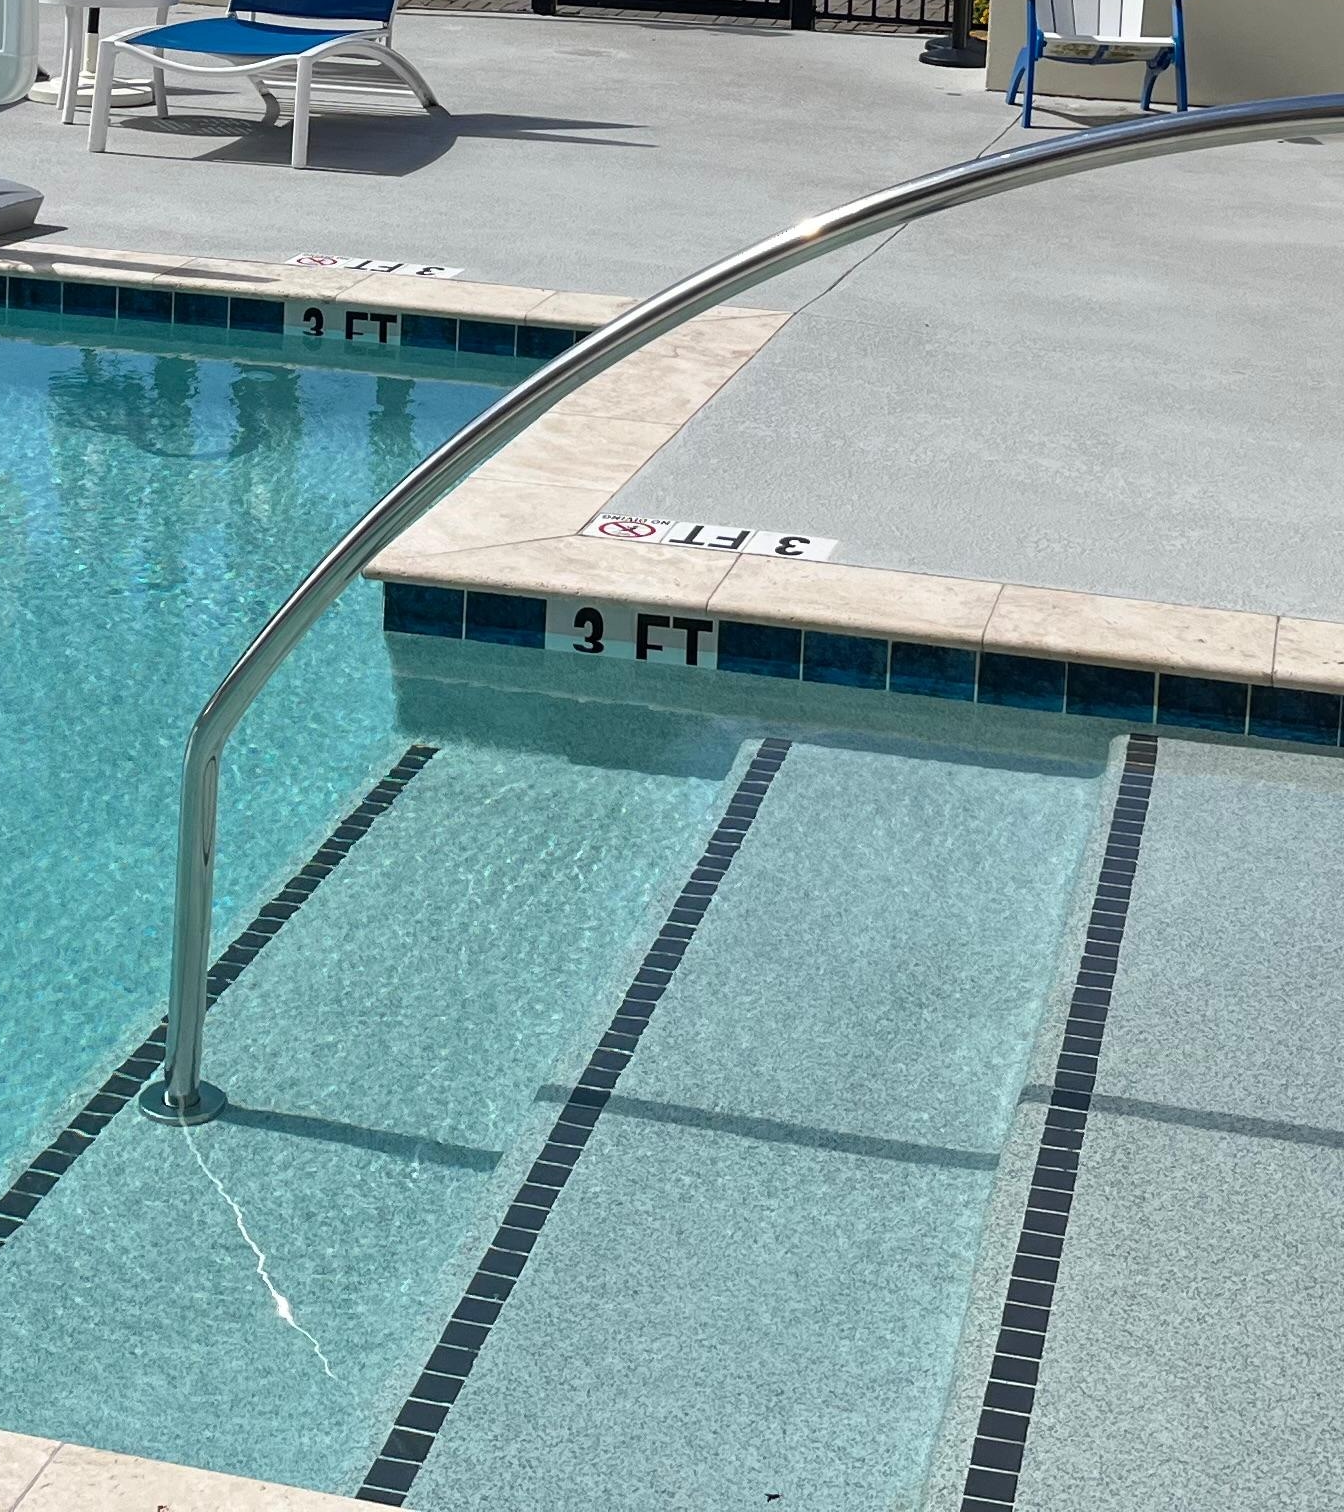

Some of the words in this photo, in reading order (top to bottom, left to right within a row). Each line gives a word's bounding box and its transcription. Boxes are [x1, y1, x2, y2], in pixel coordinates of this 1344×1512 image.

[344, 260, 404, 272] FT
[416, 266, 445, 275] 3
[302, 307, 324, 336] 3
[345, 310, 397, 343] FT
[602, 514, 648, 525] DIVING
[669, 525, 751, 550] FT
[774, 536, 811, 556] 3
[572, 607, 604, 654] 3
[636, 613, 713, 666] FT
